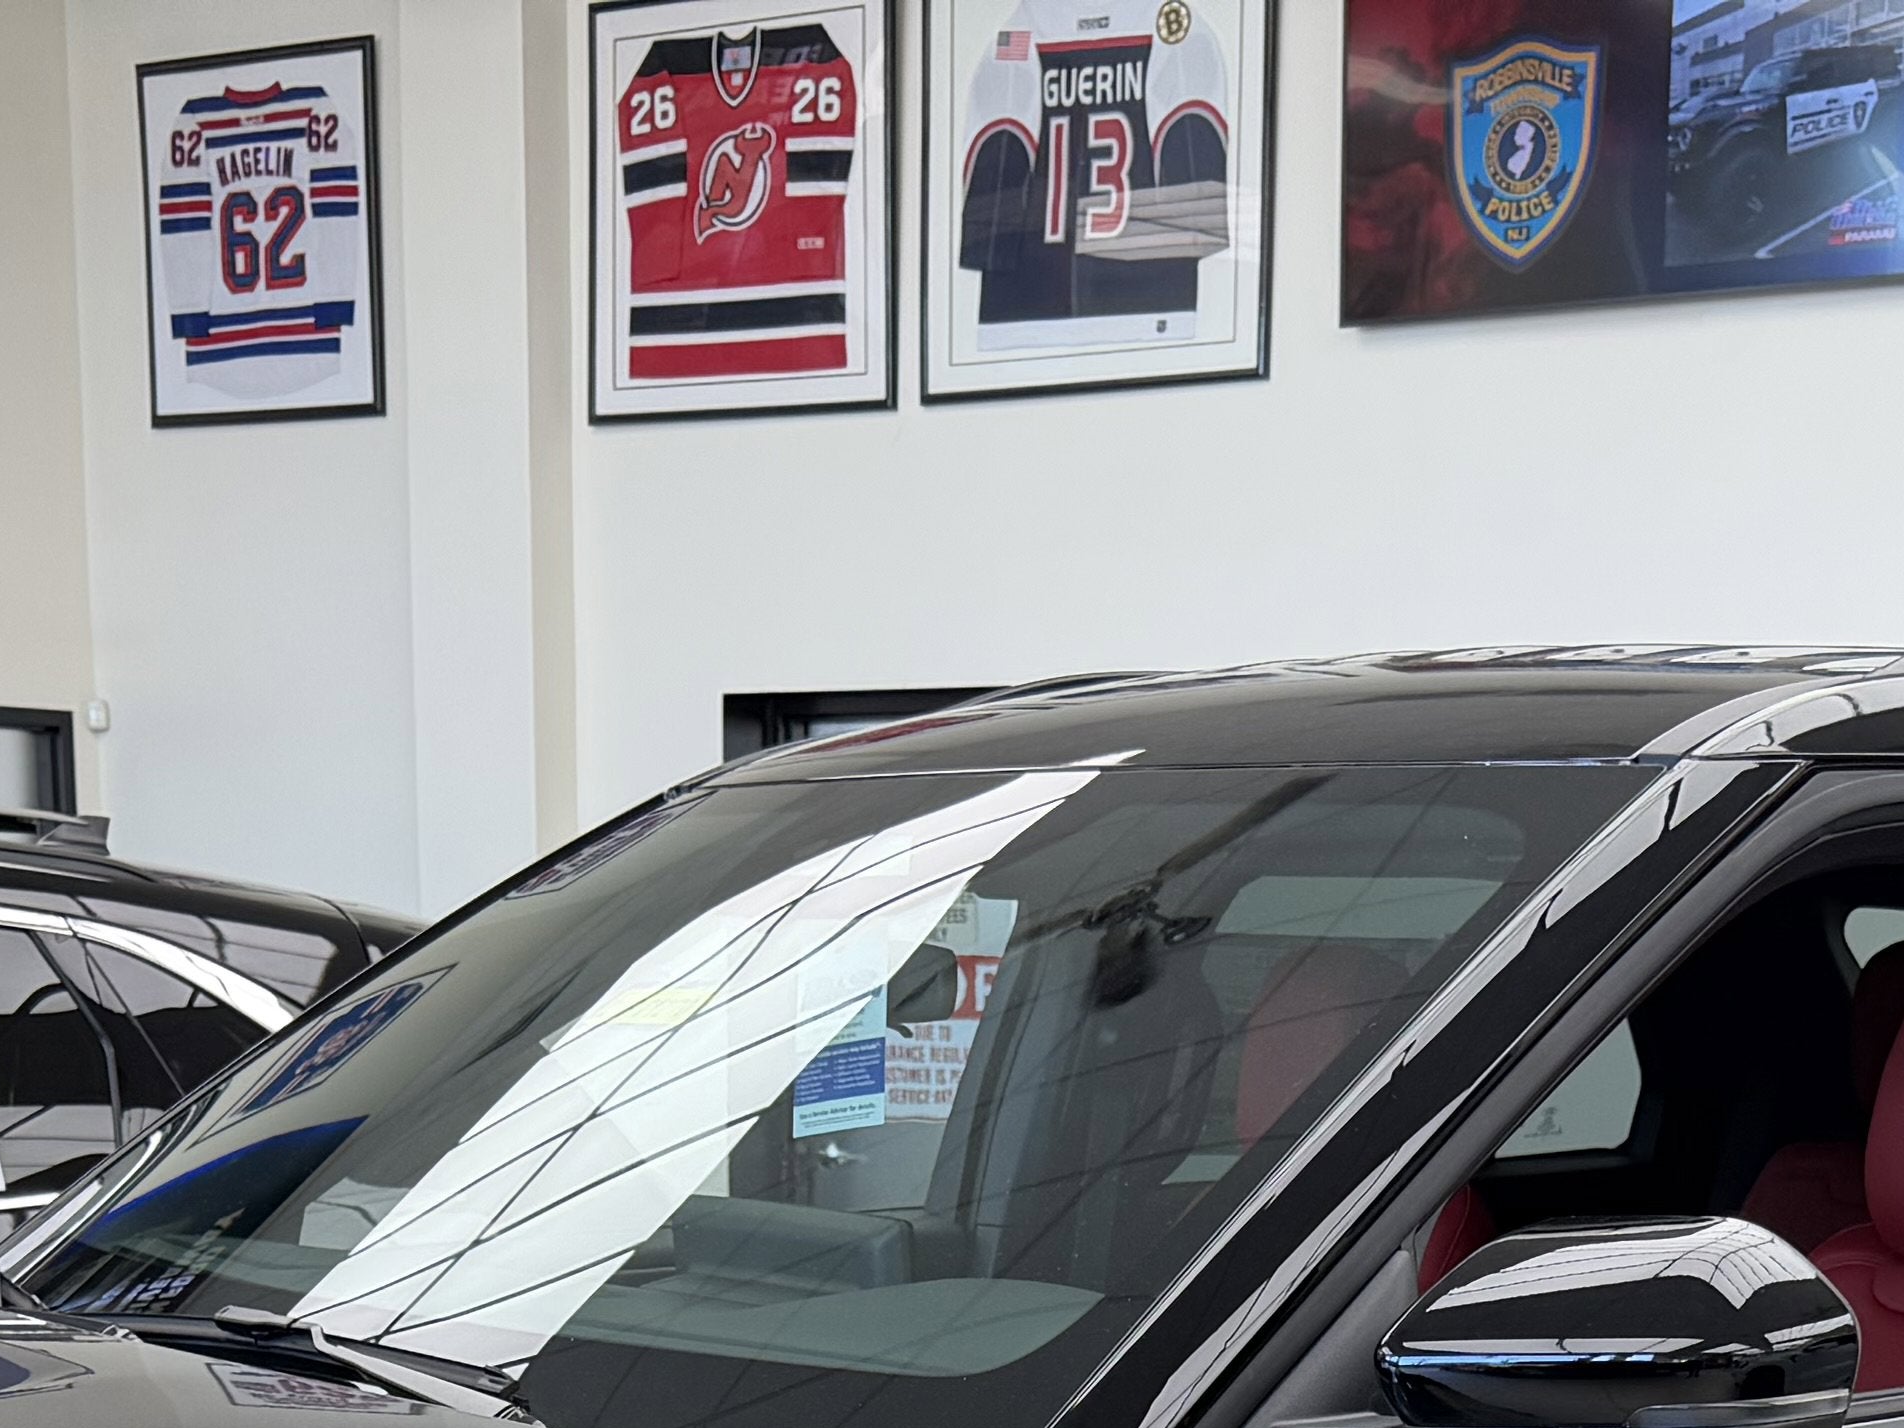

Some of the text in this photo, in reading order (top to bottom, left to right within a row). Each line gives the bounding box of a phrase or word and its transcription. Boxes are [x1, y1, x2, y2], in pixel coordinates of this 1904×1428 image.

[792, 77, 841, 123] 26
[1044, 61, 1143, 107] GUERIN
[1475, 58, 1574, 101] ROBBINSVILLE
[631, 85, 676, 135] 26
[1791, 112, 1850, 138] POLICE
[171, 130, 203, 168] 62
[307, 114, 339, 152] 62
[216, 146, 294, 187] HAGELIN
[1044, 111, 1133, 243] 13
[1485, 191, 1554, 221] POLICE
[220, 185, 307, 294] 62
